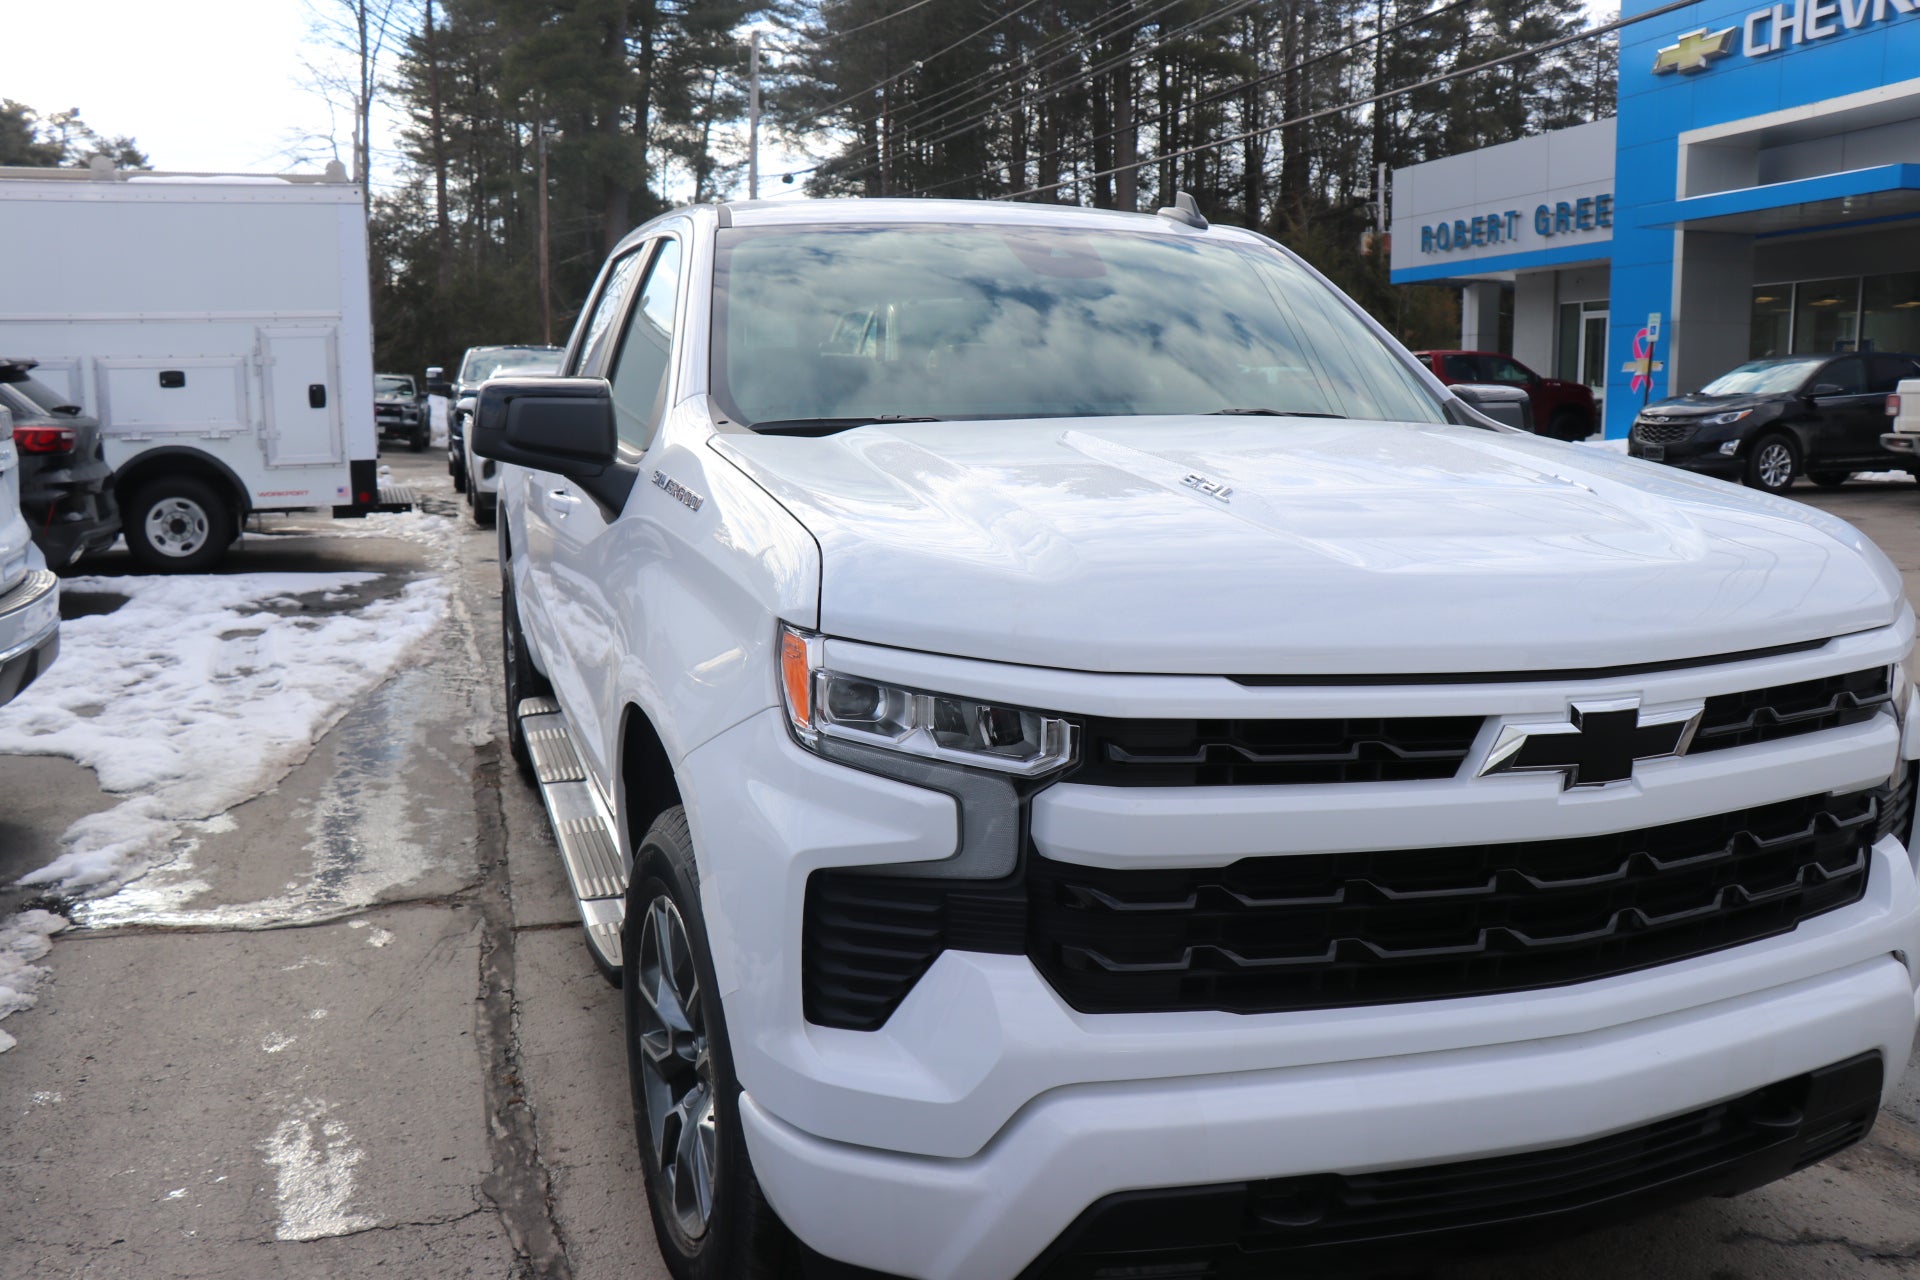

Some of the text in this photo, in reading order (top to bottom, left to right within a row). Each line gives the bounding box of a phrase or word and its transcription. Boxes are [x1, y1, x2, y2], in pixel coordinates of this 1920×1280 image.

[1743, 0, 1920, 57] CHEV
[1421, 193, 1613, 254] ROBERT GREE
